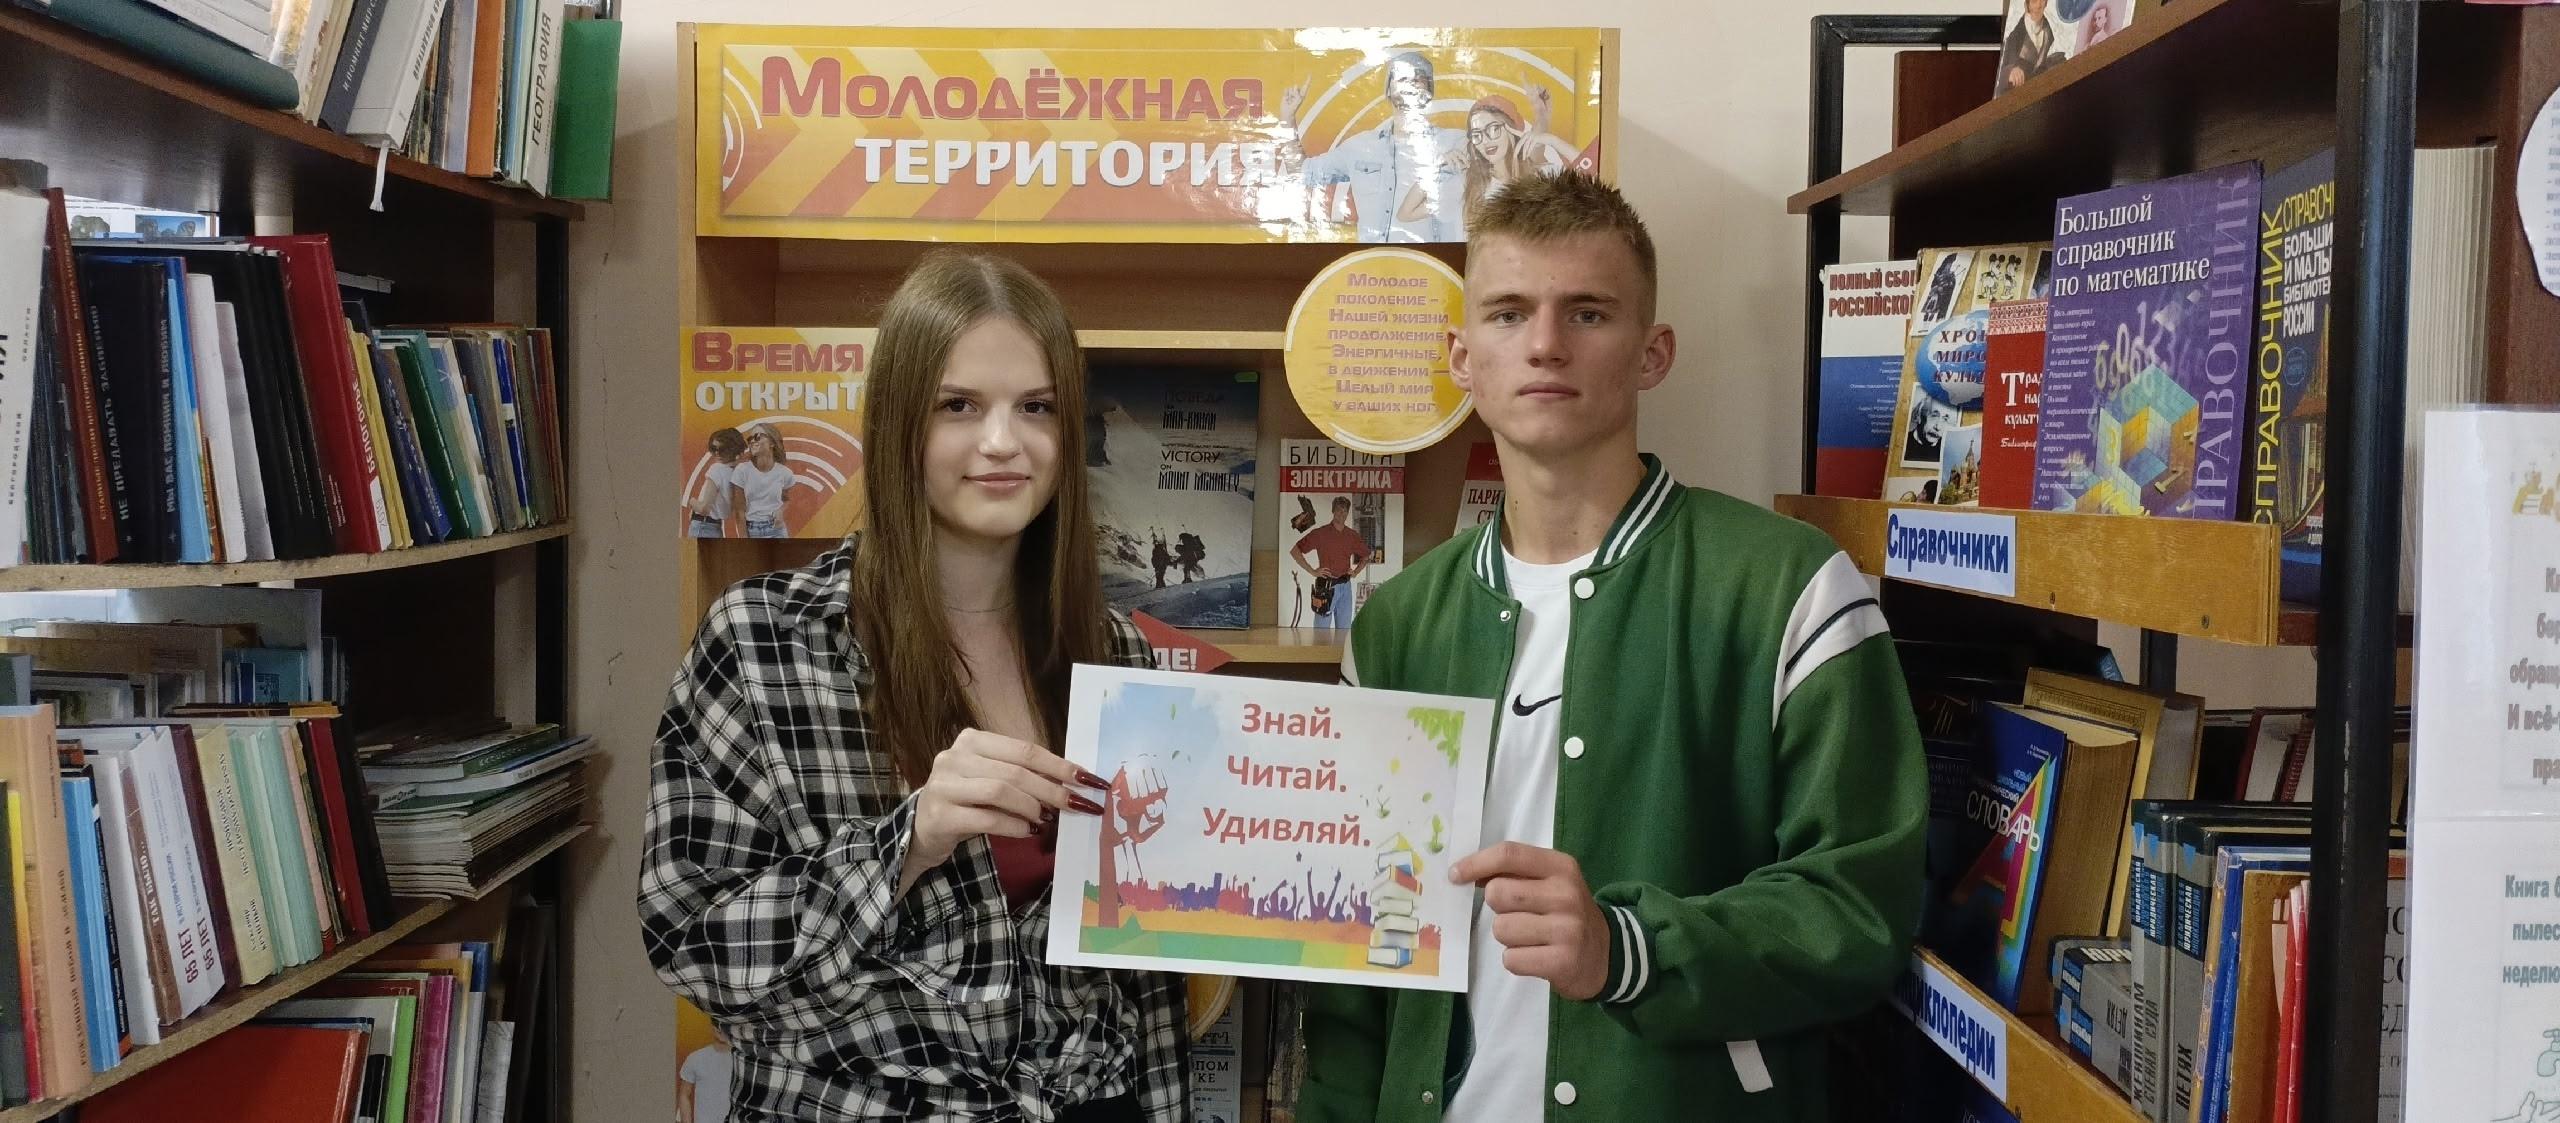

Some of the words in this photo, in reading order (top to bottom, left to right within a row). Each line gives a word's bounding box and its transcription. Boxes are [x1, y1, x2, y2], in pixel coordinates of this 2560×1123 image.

[530, 14, 551, 146] ГЕОГРАФИЯ
[855, 138, 1277, 187] ТЕРРИТОРИЯ
[2059, 194, 2153, 236] Большой
[2283, 181, 2335, 232] СПРАВОЧ
[2057, 230, 2175, 269] справочник
[1829, 268, 1882, 290] ПОЛНЫЙ
[2054, 276, 2079, 297] по
[2087, 257, 2210, 293] математике
[2284, 260, 2292, 285] И
[1336, 294, 1426, 306] ПОКОЛЕНИЕ
[1392, 313, 1448, 324] ЖИЗНИ
[2283, 301, 2315, 338] РОССИИ
[1328, 366, 1337, 375] В
[1342, 366, 1429, 377] ДВИЖЕНИИ
[1399, 382, 1434, 394] МИР
[1347, 401, 1401, 412] ВАШИХ
[105, 398, 126, 490] ПРЕДАВАТЬ
[353, 380, 376, 474] БЕЛОГОРЬЕ
[1161, 451, 1221, 463] VICTORY
[1158, 471, 1190, 491] MOUNT
[1290, 469, 1392, 488] ЭЛЕКТРИКА
[119, 496, 129, 520] НЕ
[1887, 513, 2009, 575] Справочники
[1241, 702, 1342, 740] Знай.
[1227, 754, 1347, 793] Читай.
[1203, 807, 1371, 847] Удивляй.
[1966, 790, 2041, 852] СЛОВАРЬ
[2133, 861, 2142, 924] ЮРИДИЧЕСКАЯ
[2505, 874, 2550, 899] Книга
[2149, 874, 2157, 938] ЮРИДИЧЕСКАЯ
[2184, 885, 2193, 951] ЮРИДИЧЕСКАЯ
[177, 928, 195, 963] ЛЕТ
[197, 917, 210, 947] ЛЕТ
[184, 966, 199, 985] 65
[203, 952, 215, 971] 65
[2145, 998, 2158, 1040] СУДА
[2132, 982, 2145, 1103] ЖЕНЩИНАМ
